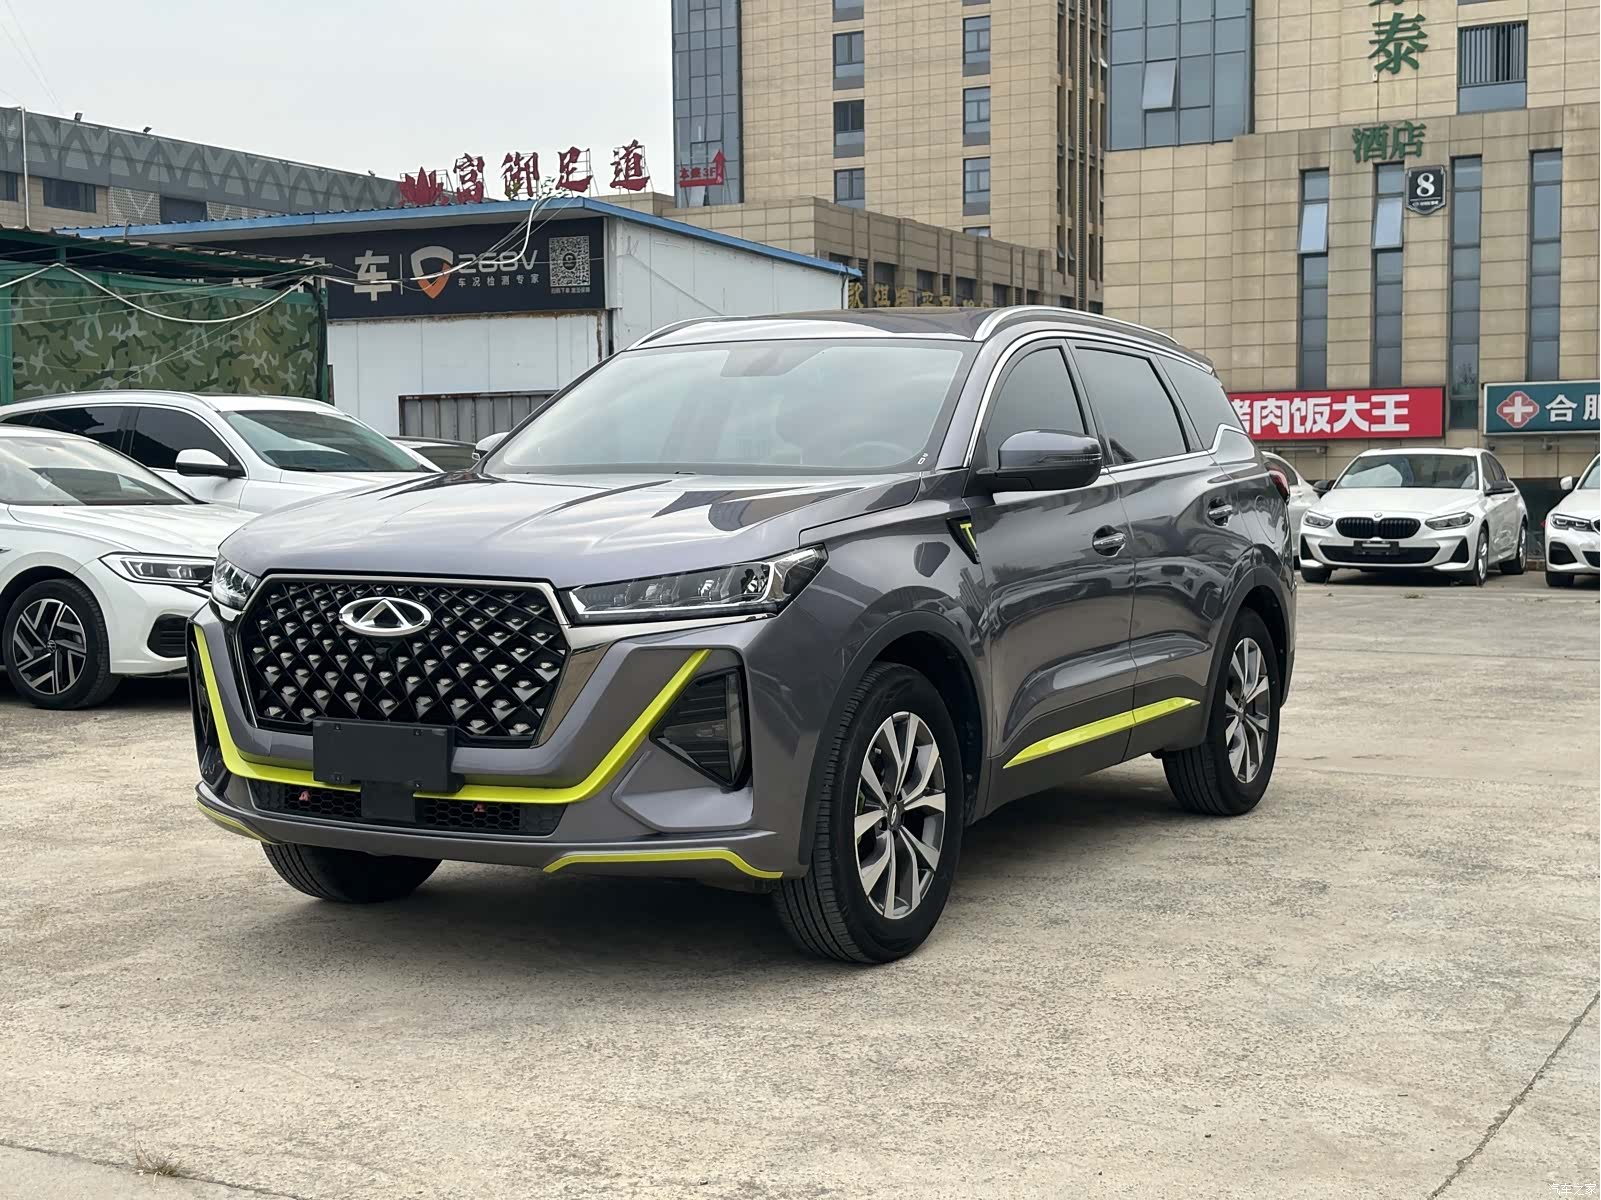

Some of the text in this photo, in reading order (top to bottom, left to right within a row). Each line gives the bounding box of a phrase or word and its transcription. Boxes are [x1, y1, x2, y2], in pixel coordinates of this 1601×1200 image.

[1368, 0, 1428, 75] 泰
[1352, 120, 1427, 163] 酒店
[1416, 172, 1435, 197] 8
[458, 273, 539, 287] 车况检测专家
